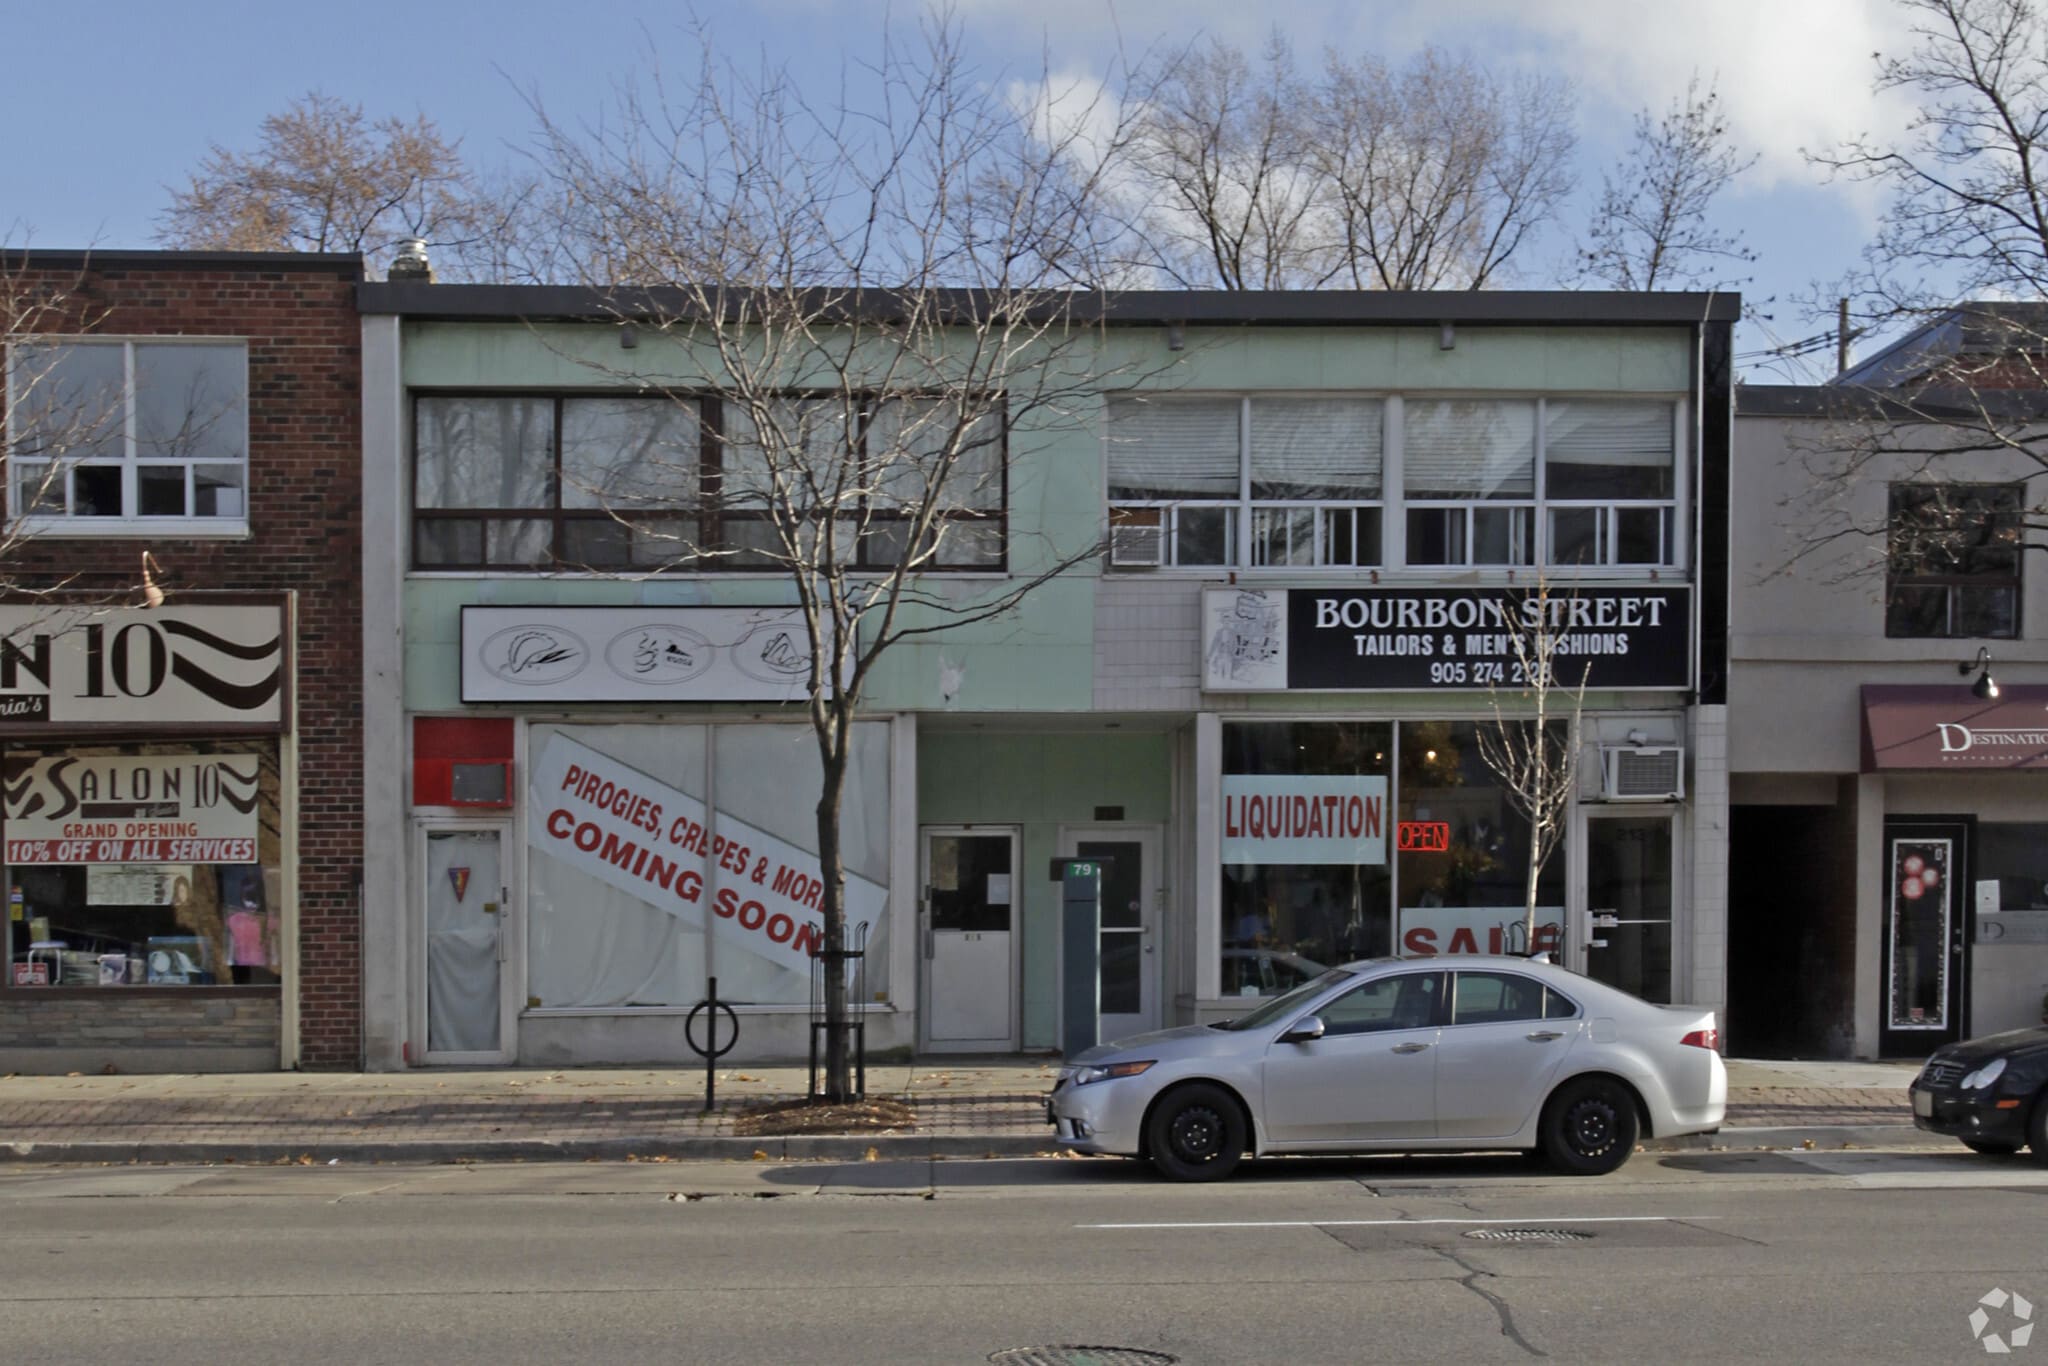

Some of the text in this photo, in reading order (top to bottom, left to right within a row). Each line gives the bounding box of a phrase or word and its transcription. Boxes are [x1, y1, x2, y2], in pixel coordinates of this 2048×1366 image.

[1315, 597, 1667, 628] BOURBON STREET
[1354, 634, 1434, 656] TAILORS
[1442, 634, 1457, 656] &
[1465, 633, 1526, 656] MEN'S
[74, 623, 167, 698] 10
[1430, 662, 1467, 684] 905
[1474, 662, 1505, 683] 274
[45, 757, 220, 821] SALON 10
[63, 822, 198, 838] GRAND OPENING
[561, 764, 662, 841] PIROGIES,
[751, 856, 768, 886] &
[1224, 793, 1382, 842] LIQUIDATION
[10, 839, 252, 861] 10% OFF ON ALL SERVICES
[1399, 825, 1447, 850] OPEN
[546, 808, 704, 904] COMING
[1073, 863, 1092, 876] 79
